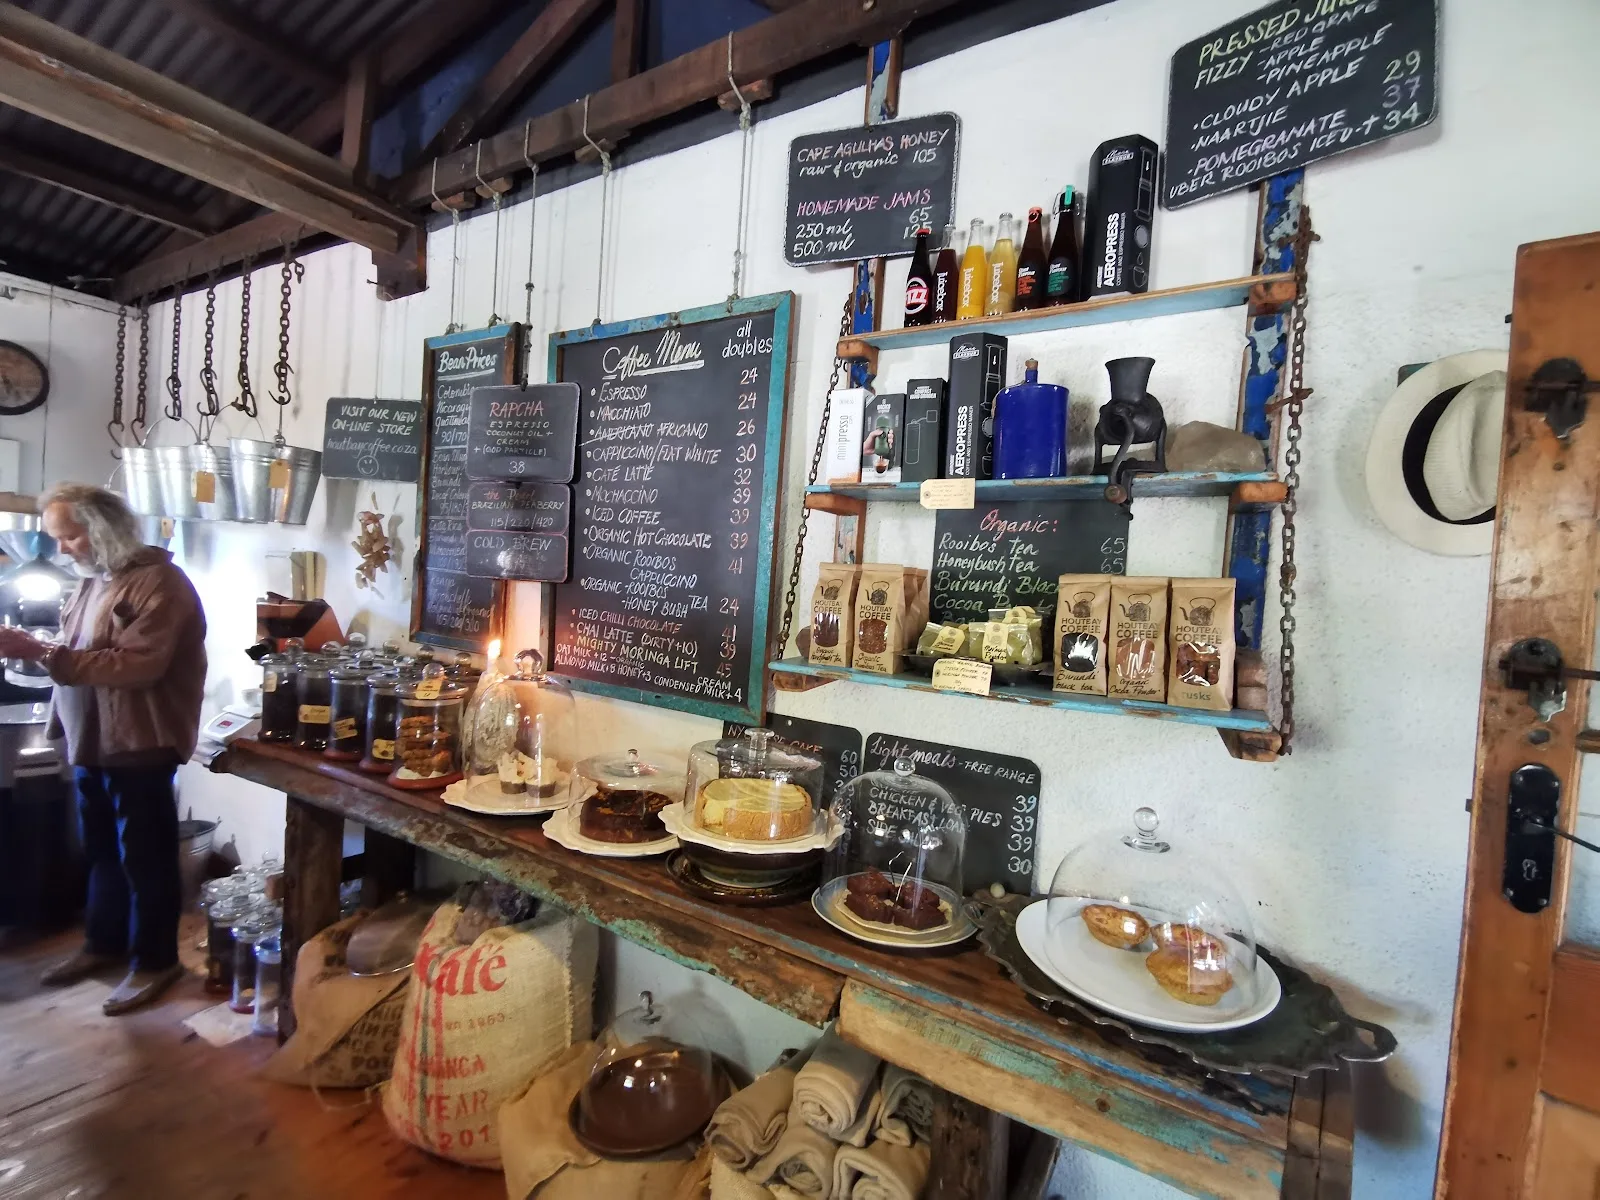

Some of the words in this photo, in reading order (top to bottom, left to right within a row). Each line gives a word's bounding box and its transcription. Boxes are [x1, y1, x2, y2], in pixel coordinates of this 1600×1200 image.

[1199, 8, 1301, 67] PRESSED
[1194, 50, 1254, 90] FIZZY
[1201, 87, 1282, 130] CLOUDY
[1286, 55, 1367, 100] APPLE
[1382, 50, 1422, 84] 29
[1196, 105, 1289, 150] NAARTJIE
[1382, 76, 1422, 109] 37
[797, 145, 833, 163] CAPE
[834, 136, 895, 158] AGULHAS
[900, 129, 949, 150] HONEY
[1169, 174, 1217, 200] UBER
[1222, 143, 1302, 182] ROOIBOS
[1383, 101, 1422, 132] 34
[1193, 109, 1348, 177] POMEGRANATE
[799, 163, 832, 177] raw
[844, 151, 899, 178] organic
[913, 147, 937, 164] 105
[796, 196, 879, 217] HOMEMADE
[884, 188, 931, 210] JAMS
[796, 223, 824, 239] 250
[826, 218, 853, 235] ml
[909, 206, 933, 224] 65
[793, 240, 822, 258] 500
[826, 235, 855, 251] ml
[1103, 212, 1120, 288] AEROPRESS
[736, 320, 752, 338] all
[602, 347, 652, 381] Coffee
[656, 330, 702, 365] Menu
[722, 336, 772, 359] doubles
[437, 351, 465, 373] Bean
[465, 346, 498, 369] Prices
[599, 382, 648, 402] ESPRESSO
[739, 368, 758, 385] 24
[341, 405, 367, 417] VISIT
[368, 408, 389, 420] OUR
[392, 410, 417, 423] NEW
[489, 400, 544, 418] RAPCHA
[597, 402, 651, 421] MACCHIATO
[738, 392, 757, 410] 24
[332, 418, 373, 432] ON-LINE
[377, 423, 413, 435] STORE
[490, 421, 550, 429] ESPRESSO
[657, 422, 709, 440] AFRICANO
[736, 420, 755, 436] 26
[496, 438, 529, 446] CREAM
[955, 405, 968, 476] AEROPRESS
[685, 443, 721, 464] WHITE
[736, 443, 756, 463] 30
[508, 461, 526, 474] 38
[733, 468, 752, 485] 32
[471, 501, 514, 510] BRAZILIAN
[592, 486, 659, 505] MOCHACCINO
[732, 487, 751, 505] 39
[592, 505, 614, 521] ICED
[618, 507, 662, 526] COFFEE
[730, 508, 750, 525] 39
[474, 536, 504, 549] COLD
[512, 537, 552, 552] BREW
[588, 525, 630, 544] ORGANIC
[635, 528, 655, 546] HOT
[654, 527, 712, 549] CHOCOLATE
[729, 532, 749, 549] 39
[938, 532, 997, 554] Rooibos
[1100, 537, 1126, 555] 65
[586, 542, 631, 565] ORGANIC
[634, 549, 677, 571] ROOIBOS
[728, 557, 743, 574] 41
[936, 552, 1006, 580] Honeybush
[1100, 558, 1126, 575] 65
[583, 578, 623, 595] ORGANIC
[630, 567, 698, 589] CAPPUCCINO
[934, 570, 1011, 594] Burundi
[1016, 576, 1059, 595] Blac
[661, 602, 688, 618] BUSH
[689, 594, 709, 612] TEA
[720, 597, 740, 617] 24
[813, 606, 842, 615] COFFEE
[814, 599, 842, 607] HOUTBAY
[860, 604, 893, 613] HOUTBAY
[934, 593, 988, 614] Cocoa
[578, 607, 599, 621] ICED
[600, 610, 625, 626] CHILLI
[627, 616, 684, 634] CHOCOLATE
[722, 624, 737, 642] 41
[859, 611, 892, 621] COFFEE
[1061, 617, 1101, 625] HOUTBAY
[1117, 622, 1159, 630] HOUTBAY
[577, 621, 600, 638] CHAI
[603, 627, 634, 644] LATTE
[719, 643, 737, 660] 39
[1060, 625, 1101, 634] COFFEE
[1116, 630, 1158, 639] COFFEE
[1175, 633, 1222, 644] COFFEE
[1176, 625, 1222, 634] HOUTBAY
[556, 644, 571, 655] OAT
[573, 647, 593, 658] MILK
[576, 635, 618, 654] MIGHTY
[619, 644, 672, 668] MORINGA
[674, 656, 699, 675] LIFT
[716, 663, 732, 679] 45
[554, 655, 587, 670] ALMOND
[654, 675, 702, 695] CONDENSED
[697, 676, 732, 691] CREAM
[1056, 670, 1100, 681] Burundi
[840, 749, 857, 764] 60
[870, 736, 912, 767] Light
[910, 748, 957, 768] meals
[994, 767, 1036, 784] RANGE
[839, 764, 858, 778] 50
[870, 786, 927, 809] CHICKEN
[970, 807, 1003, 828] PIES
[1010, 815, 1035, 832] 39
[1012, 795, 1037, 813] 39
[868, 800, 938, 826] BREAKFAST
[1007, 833, 1033, 853] 39
[866, 818, 898, 839] SIDE
[1007, 856, 1032, 874] 30
